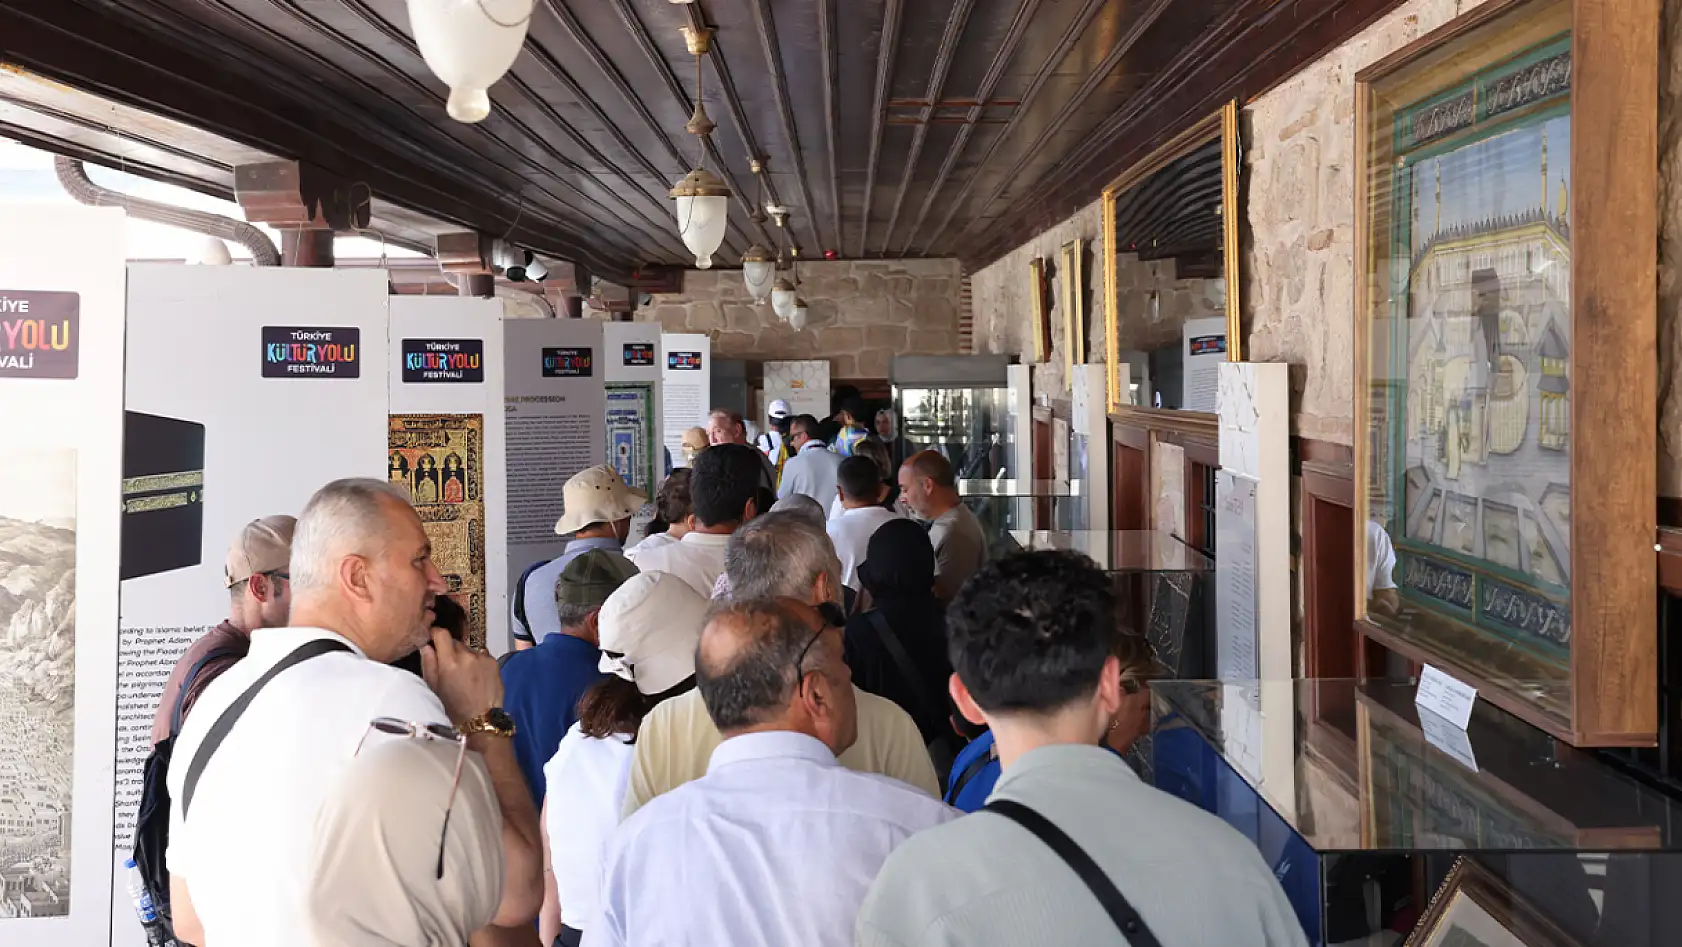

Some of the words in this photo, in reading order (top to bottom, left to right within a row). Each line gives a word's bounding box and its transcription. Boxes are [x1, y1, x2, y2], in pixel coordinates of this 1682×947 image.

[290, 330, 332, 341] TÜRKİYE
[287, 363, 336, 374] FESTİVALİ
[127, 659, 158, 667] Prophet
